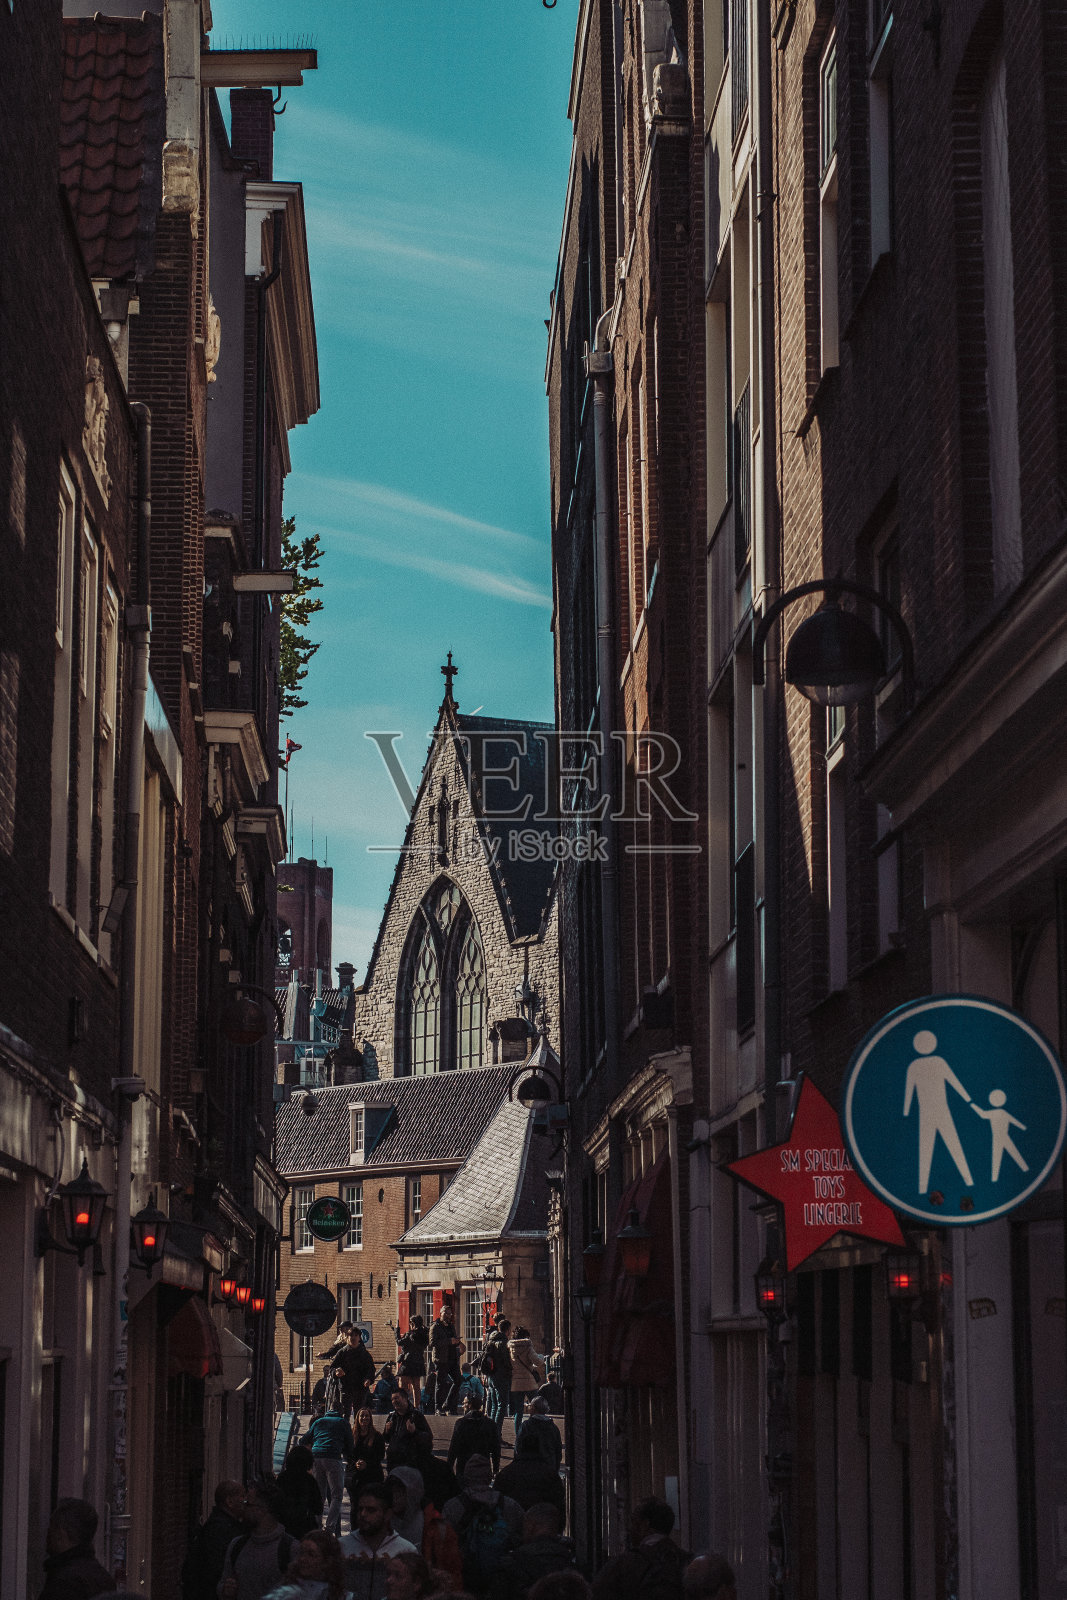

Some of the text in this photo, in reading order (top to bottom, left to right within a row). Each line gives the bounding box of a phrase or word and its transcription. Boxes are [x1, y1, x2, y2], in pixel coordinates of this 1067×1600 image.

[780, 1148, 854, 1173] SM SPECIA
[812, 1175, 845, 1199] TOYS
[803, 1202, 863, 1226] LINGERIE
